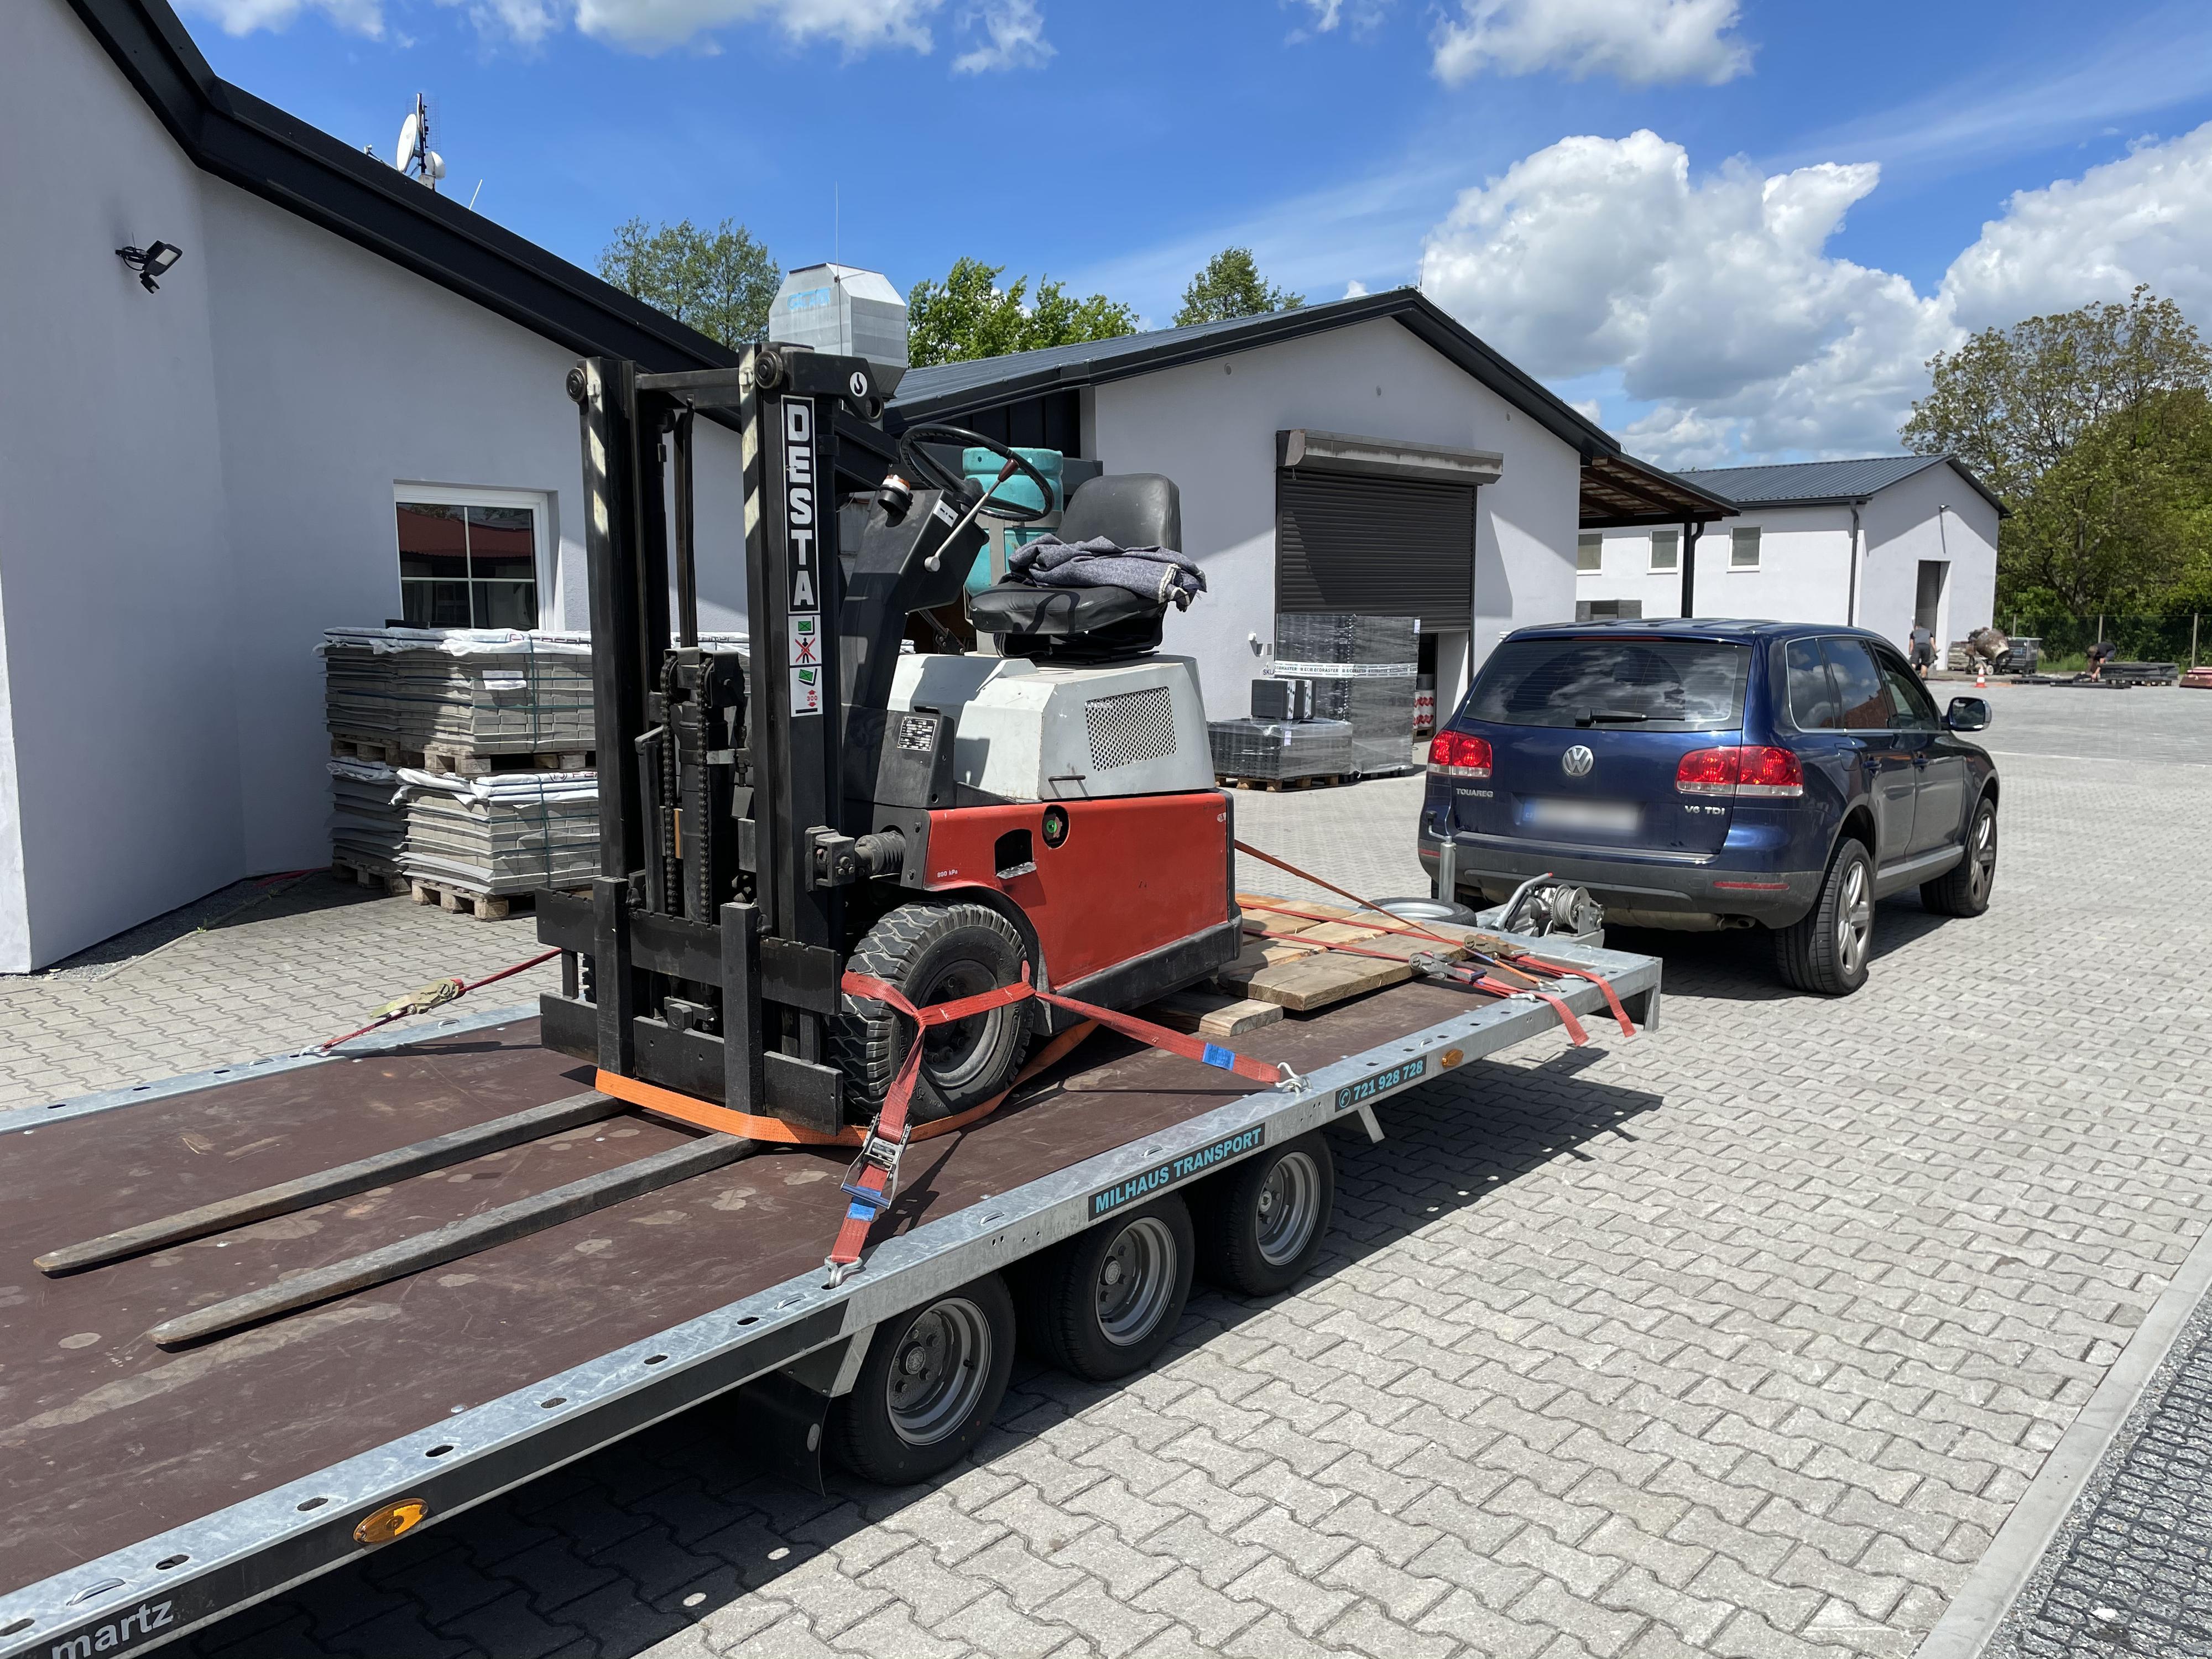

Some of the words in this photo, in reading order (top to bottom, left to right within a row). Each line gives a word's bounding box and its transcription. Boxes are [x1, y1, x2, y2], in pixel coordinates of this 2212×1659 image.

[787, 404, 815, 606] DESTA
[1456, 788, 1494, 797] TOUAREG
[1684, 805, 1700, 813] V6
[1704, 806, 1725, 816] TDI
[1354, 1079, 1376, 1100] 721
[1378, 1070, 1400, 1090] 928
[1402, 1060, 1424, 1079] 728
[1095, 1166, 1170, 1213] MILHAUS
[1173, 1128, 1262, 1177] TRANSPORT
[52, 1600, 174, 1659] martz
